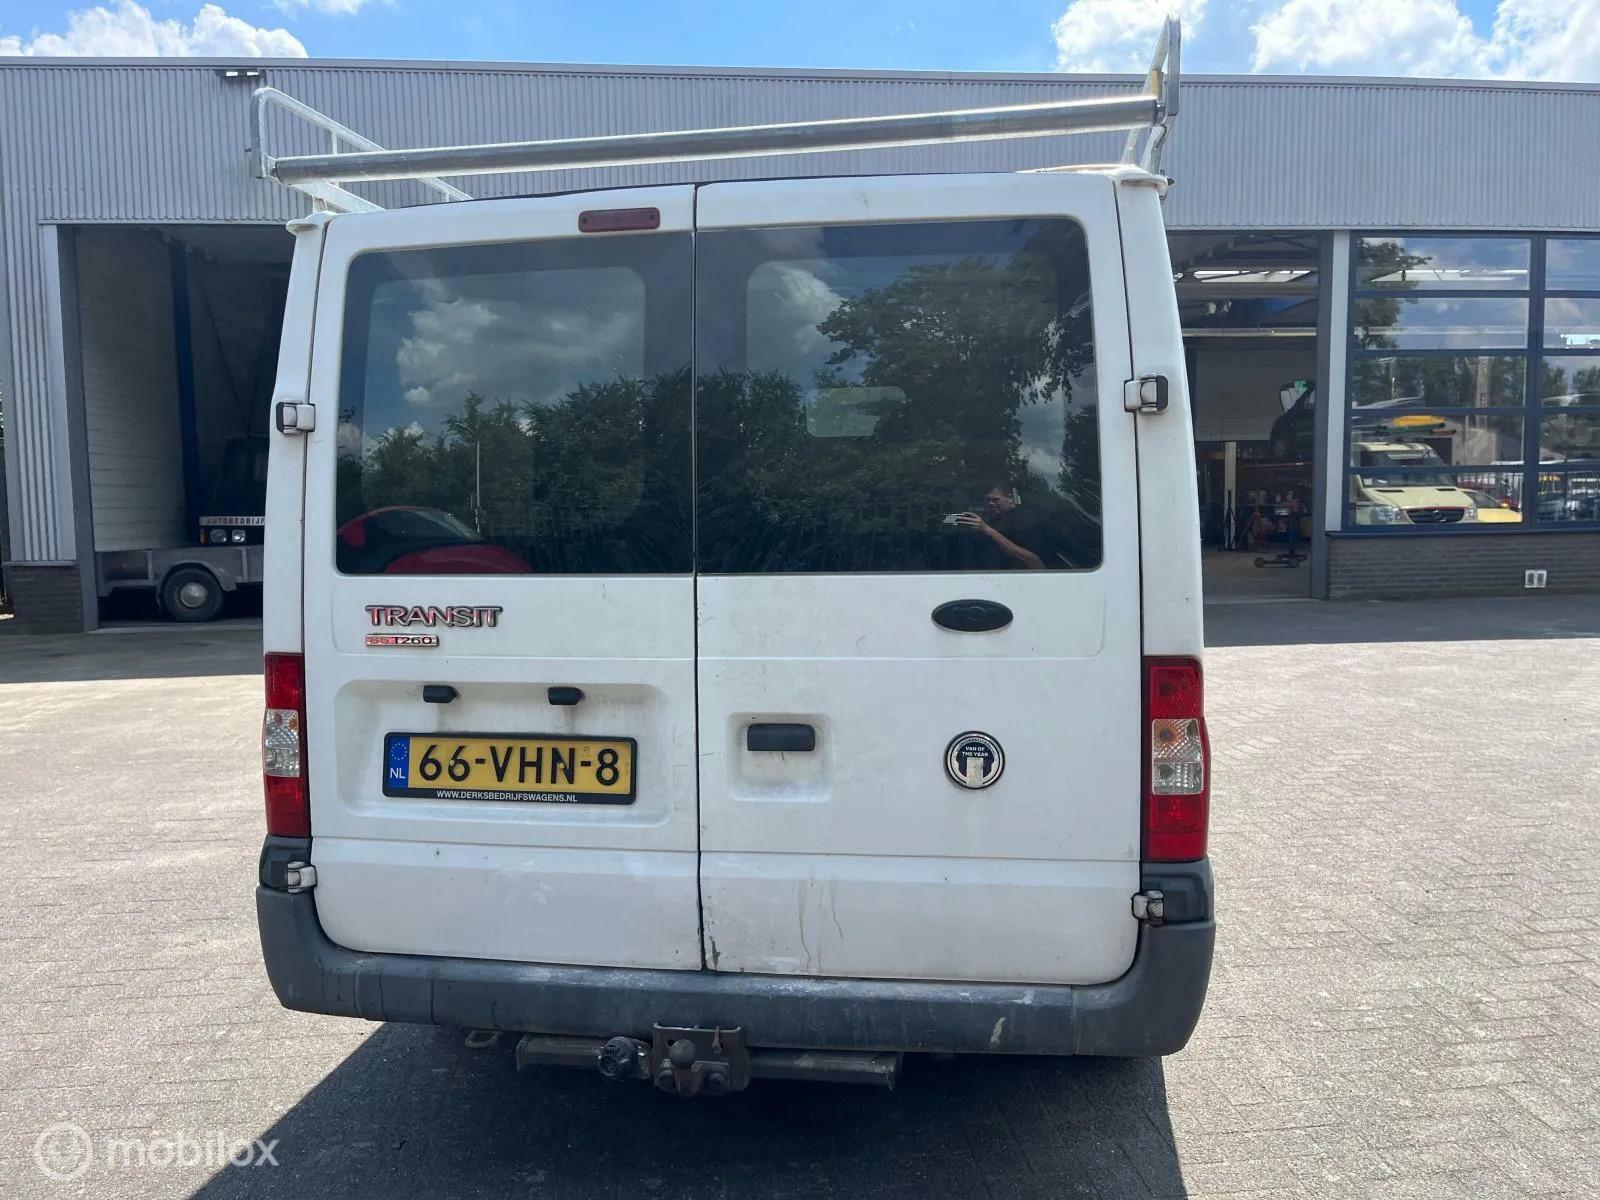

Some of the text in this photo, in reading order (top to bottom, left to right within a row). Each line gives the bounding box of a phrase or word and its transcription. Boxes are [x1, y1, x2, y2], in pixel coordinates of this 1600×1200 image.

[365, 605, 503, 627] TRANSIT
[390, 767, 406, 779] NL
[419, 744, 620, 786] 66-VHN-8
[436, 789, 578, 803] WWW.DERKSBEDRIJFSWAGENS.NL
